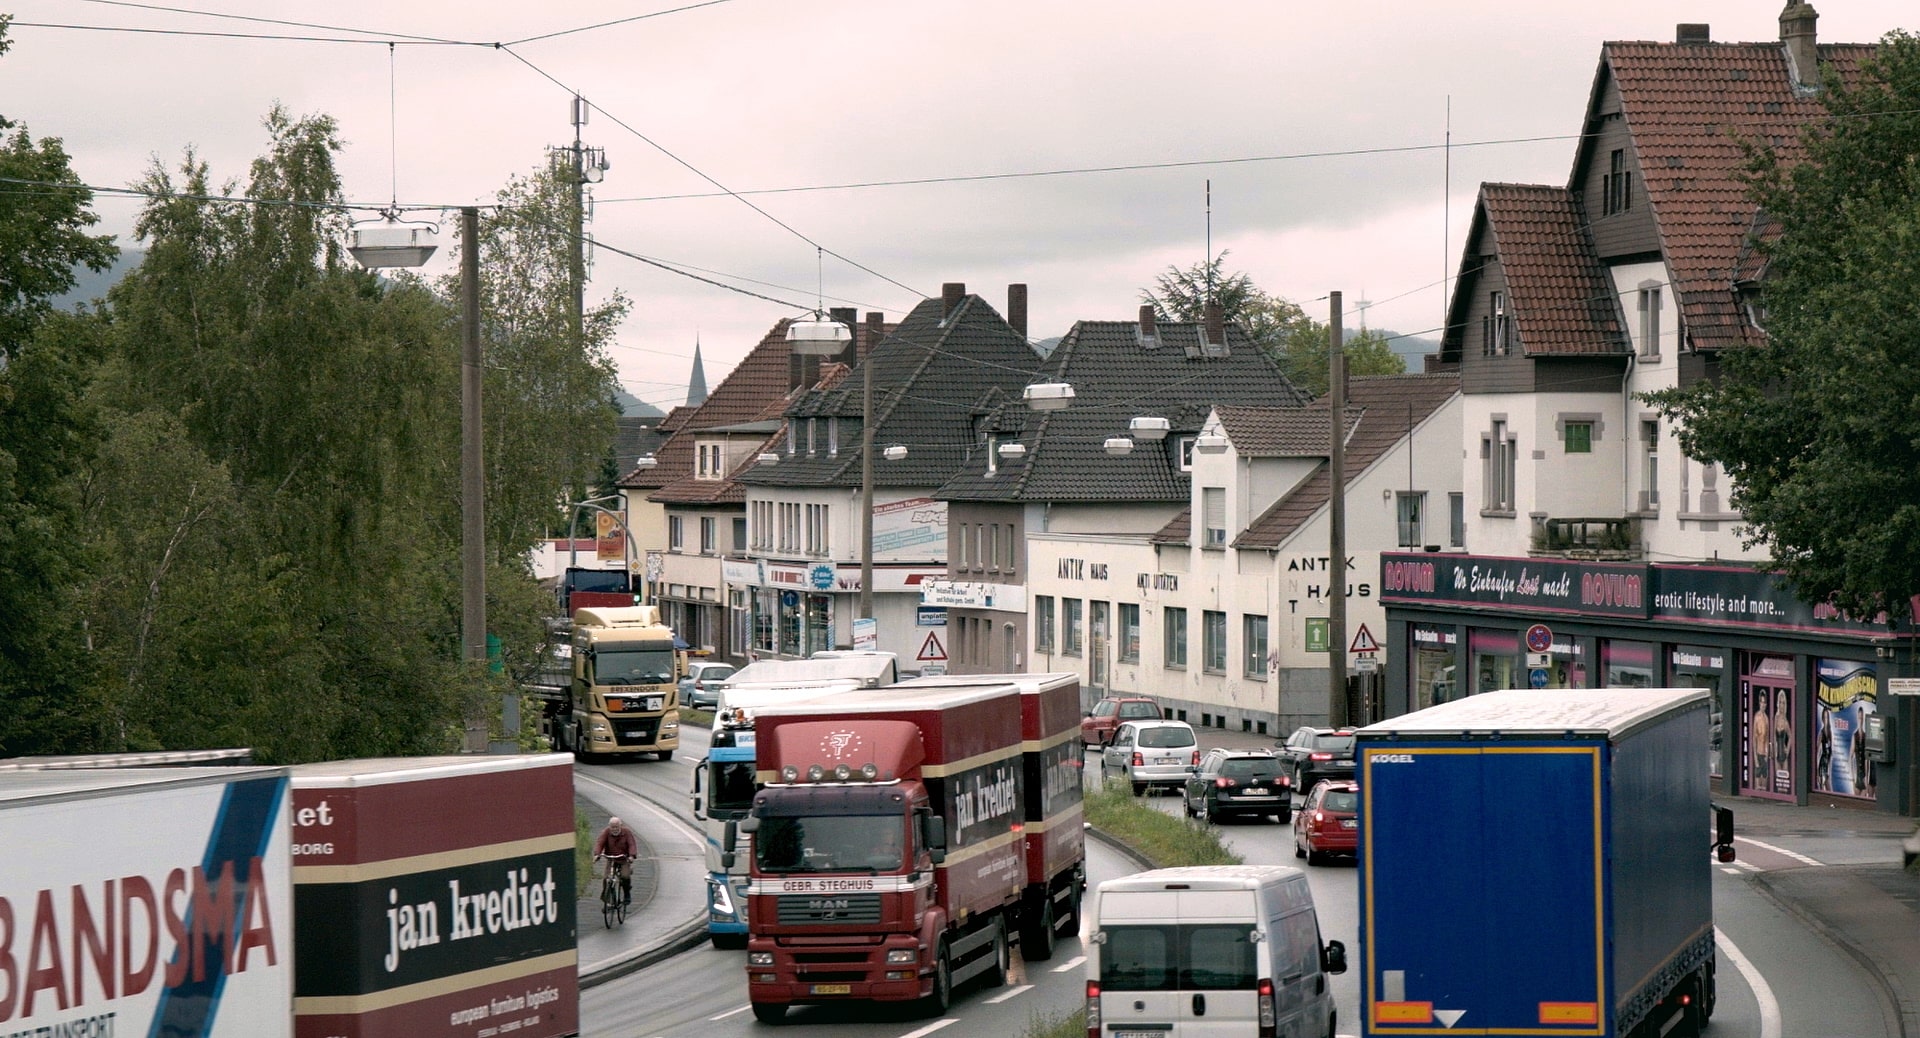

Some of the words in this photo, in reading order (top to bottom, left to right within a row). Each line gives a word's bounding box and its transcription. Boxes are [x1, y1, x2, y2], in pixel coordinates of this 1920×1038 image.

[1058, 557, 1084, 581] ANTIK
[1090, 563, 1108, 580] HAUS
[1288, 556, 1356, 571] ANTK
[1385, 561, 1435, 592] NOVUM
[1454, 565, 1467, 590] Wo
[1471, 565, 1515, 600] Einkaufen
[1542, 571, 1570, 598] macht
[1581, 572, 1642, 608] NOVUM
[1655, 592, 1682, 608] erotic
[1685, 592, 1725, 615] lifestyle
[1728, 594, 1746, 614] and
[1750, 599, 1785, 616] more...
[956, 780, 974, 844] jan
[976, 766, 1016, 822] krediet
[784, 881, 816, 891] GEBR.
[820, 880, 874, 890] STEGHUIS
[809, 900, 848, 909] MAN
[384, 888, 440, 972] jan
[449, 867, 558, 942] krediet
